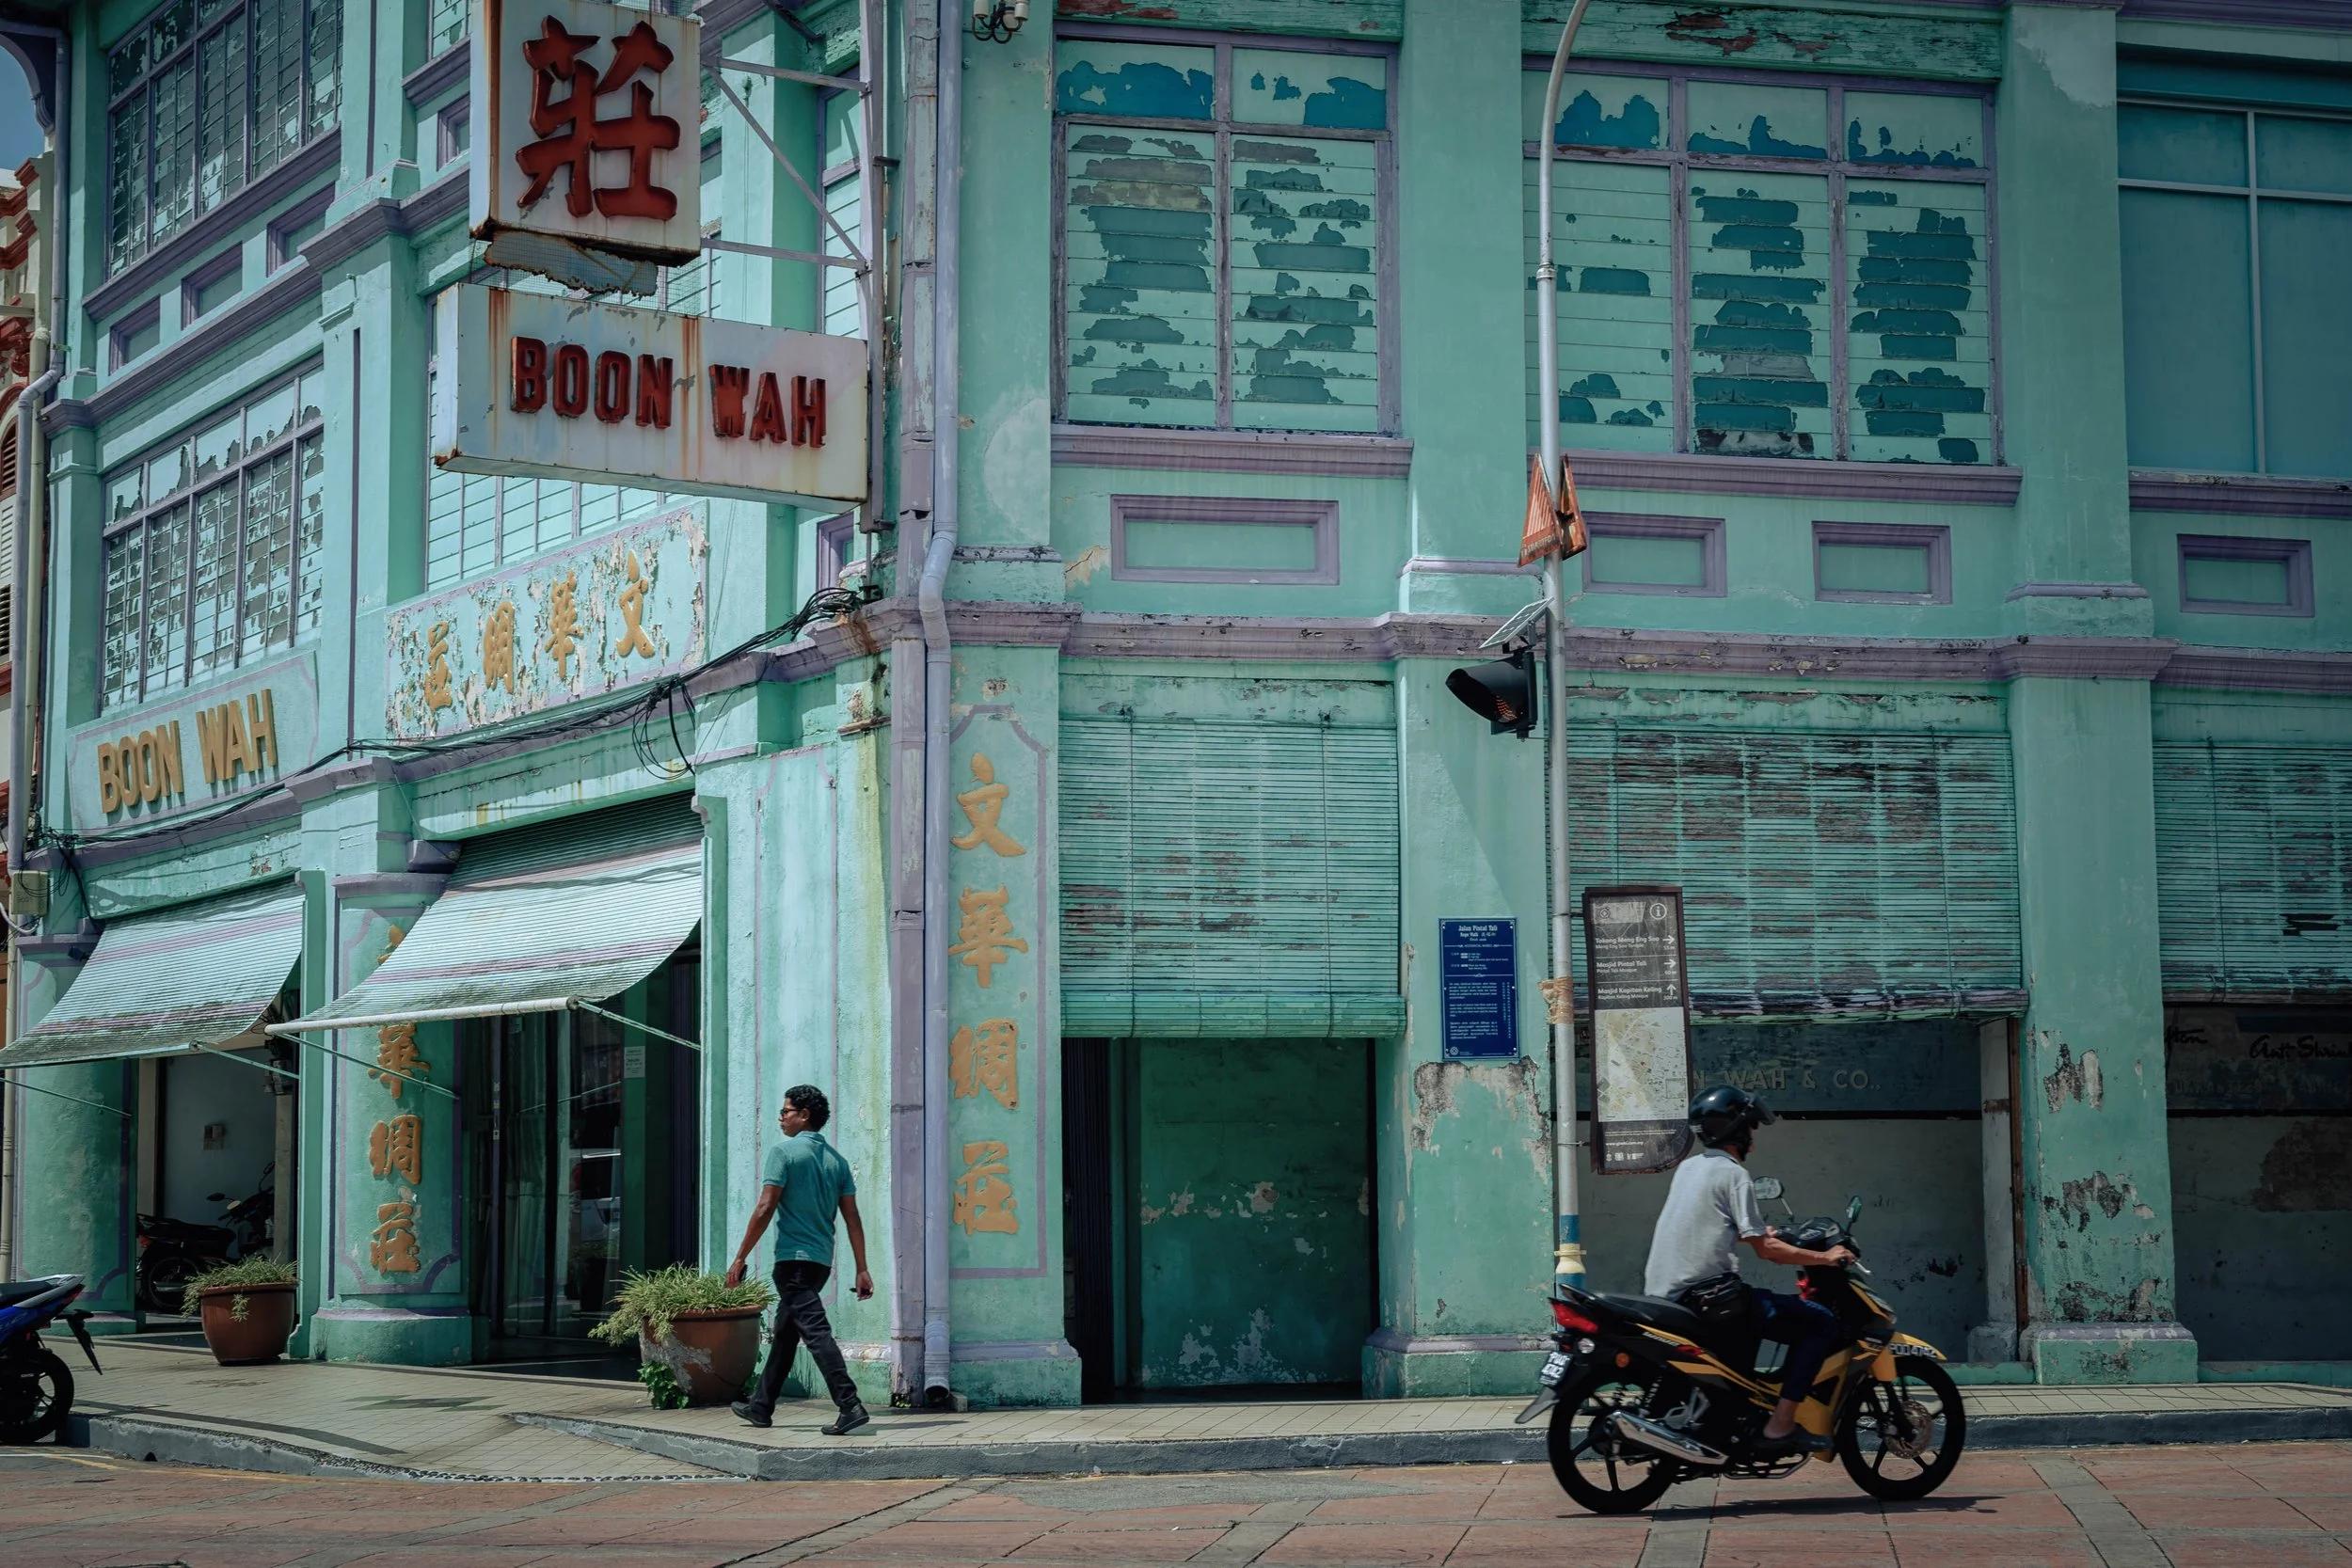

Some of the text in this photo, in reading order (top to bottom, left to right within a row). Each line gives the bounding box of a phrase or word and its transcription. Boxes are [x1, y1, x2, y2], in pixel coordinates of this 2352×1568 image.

[510, 337, 827, 449] BOON WAH
[97, 689, 278, 814] BOON WAH
[1724, 1068, 1788, 1090] WAH
[1802, 1069, 1818, 1090] &
